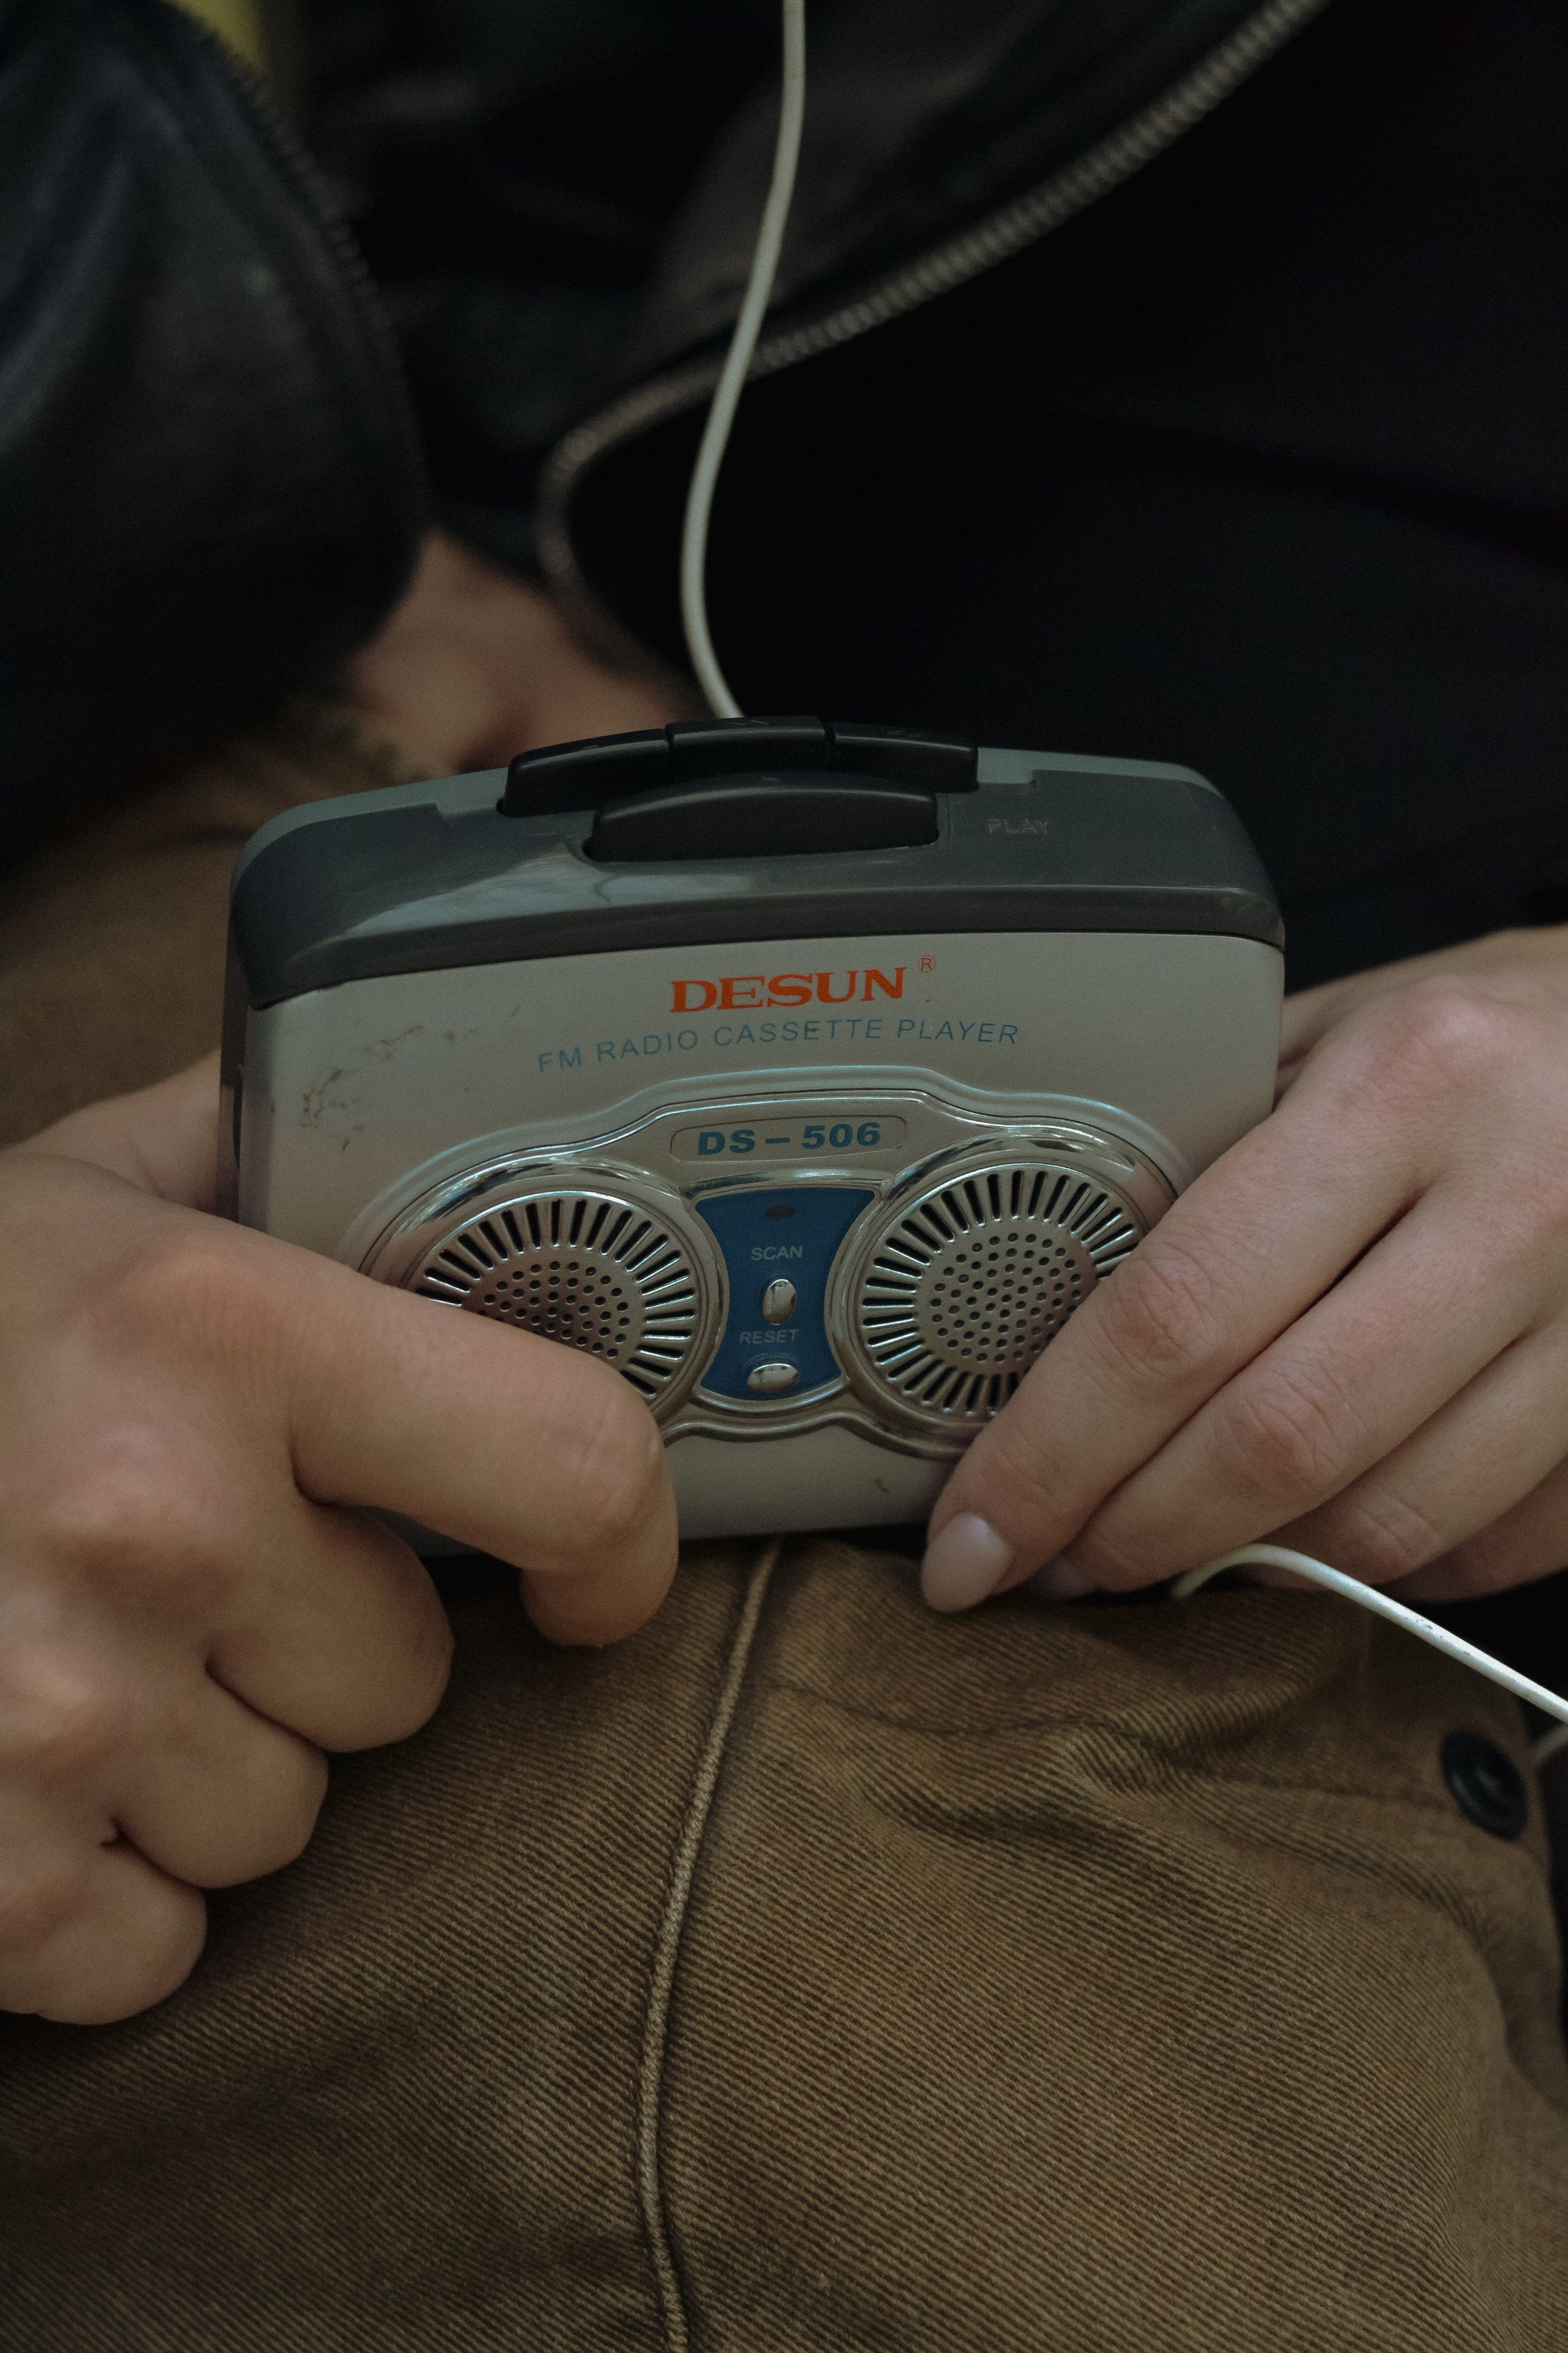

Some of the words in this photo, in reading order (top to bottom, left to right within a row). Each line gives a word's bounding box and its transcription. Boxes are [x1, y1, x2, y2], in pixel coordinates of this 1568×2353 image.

[987, 818, 1048, 836] PLAY
[670, 967, 907, 1013] DESUN
[538, 1048, 581, 1073] FM
[597, 1030, 698, 1062] RADIO
[714, 1019, 882, 1046] CASSETTE
[897, 1019, 1018, 1044] PLAYER
[752, 1245, 802, 1261] SCAN
[739, 1329, 799, 1345] RESET
